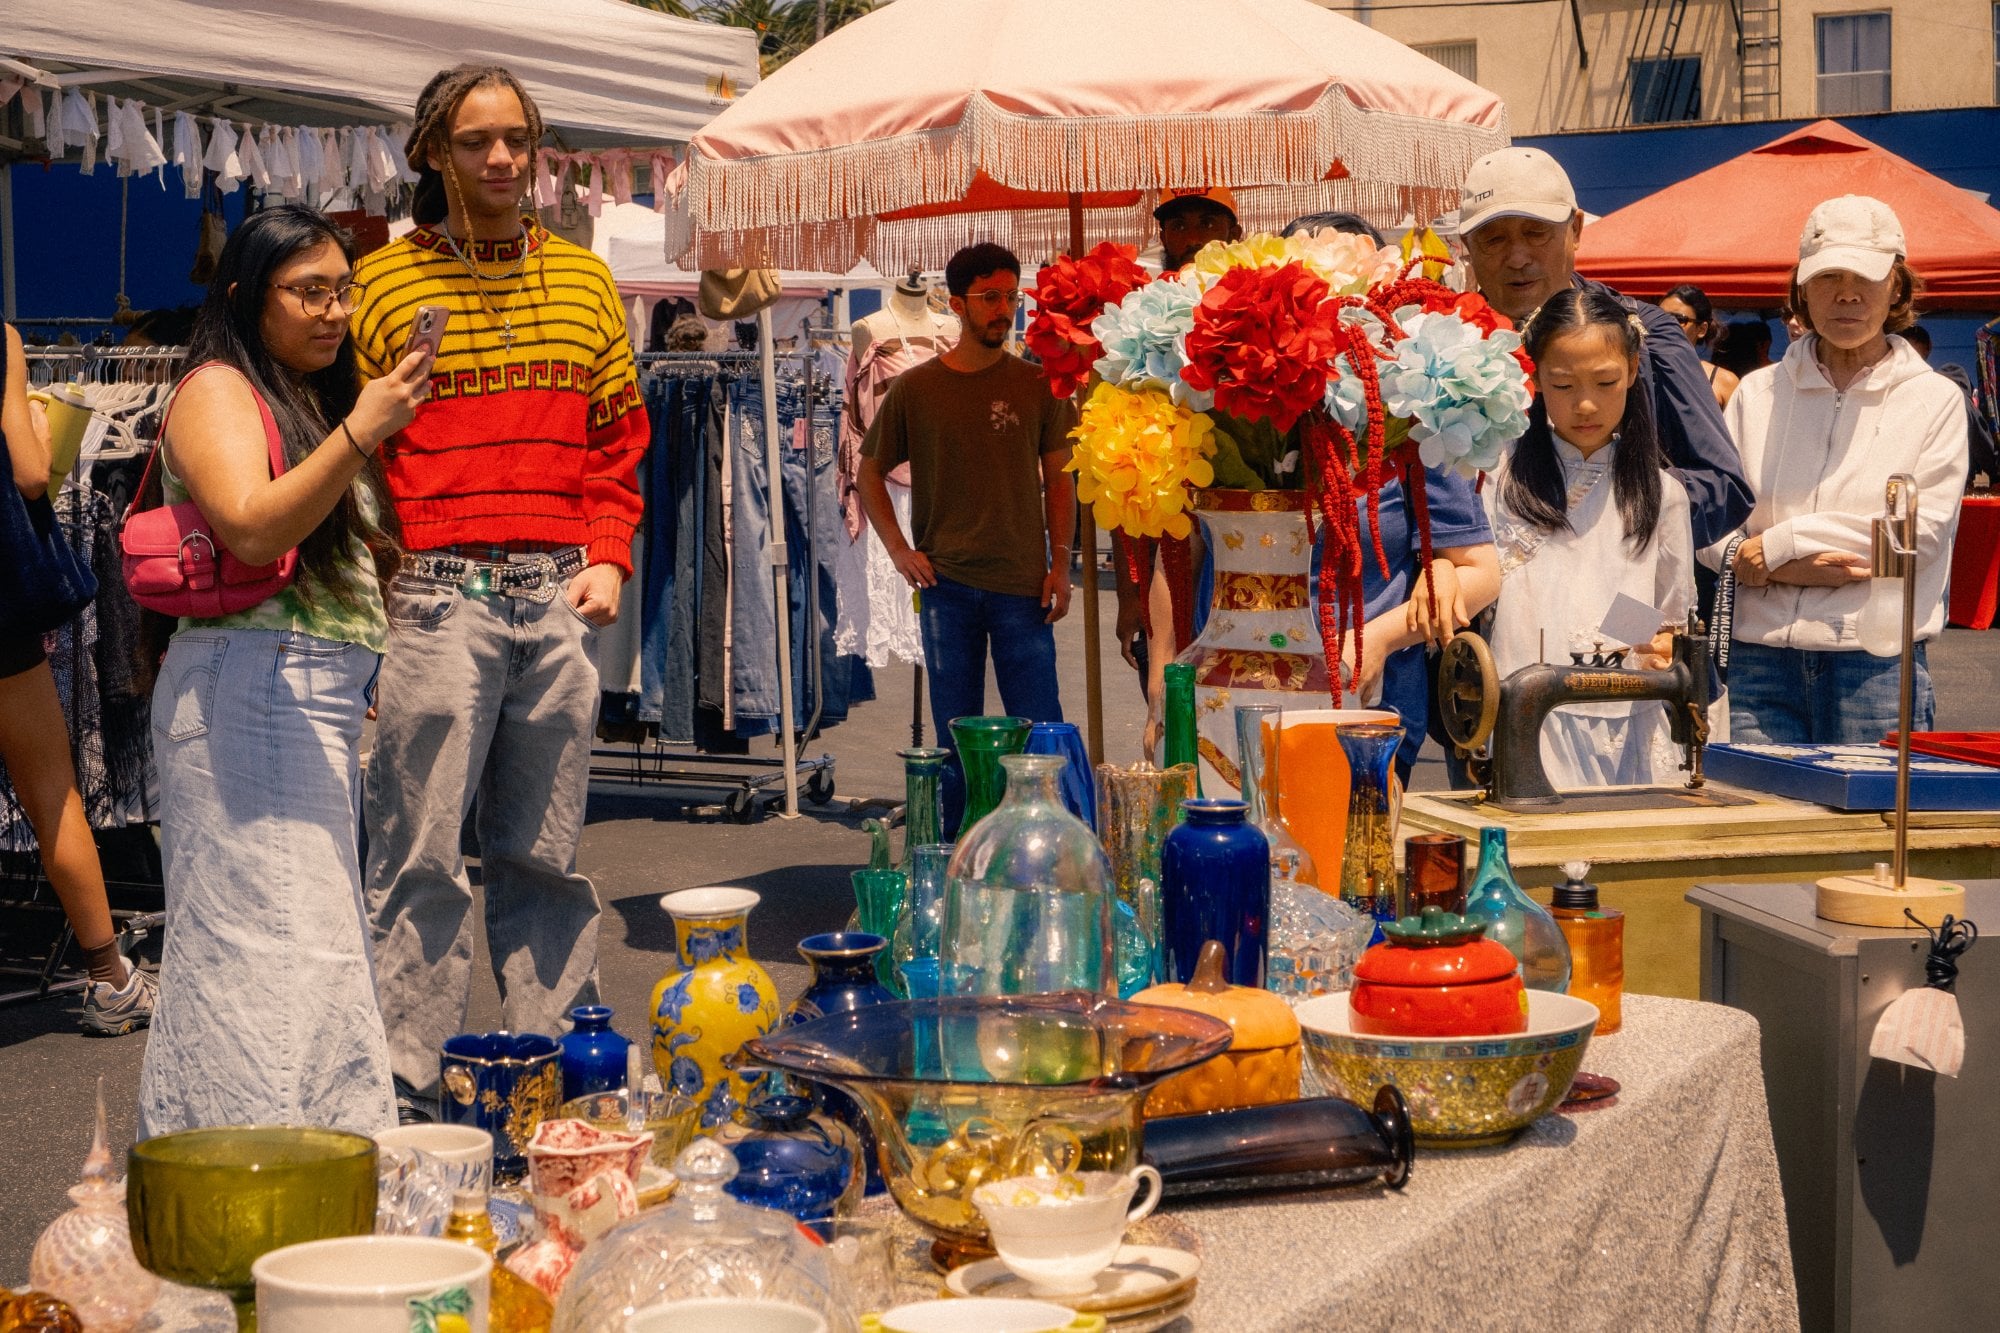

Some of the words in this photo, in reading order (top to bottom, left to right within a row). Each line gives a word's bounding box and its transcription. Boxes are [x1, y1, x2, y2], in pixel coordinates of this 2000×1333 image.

[1721, 569, 1734, 612] HUNAN
[1719, 614, 1732, 667] MUSEUM
[1581, 677, 1608, 687] NEW
[1611, 676, 1646, 688] HOME
